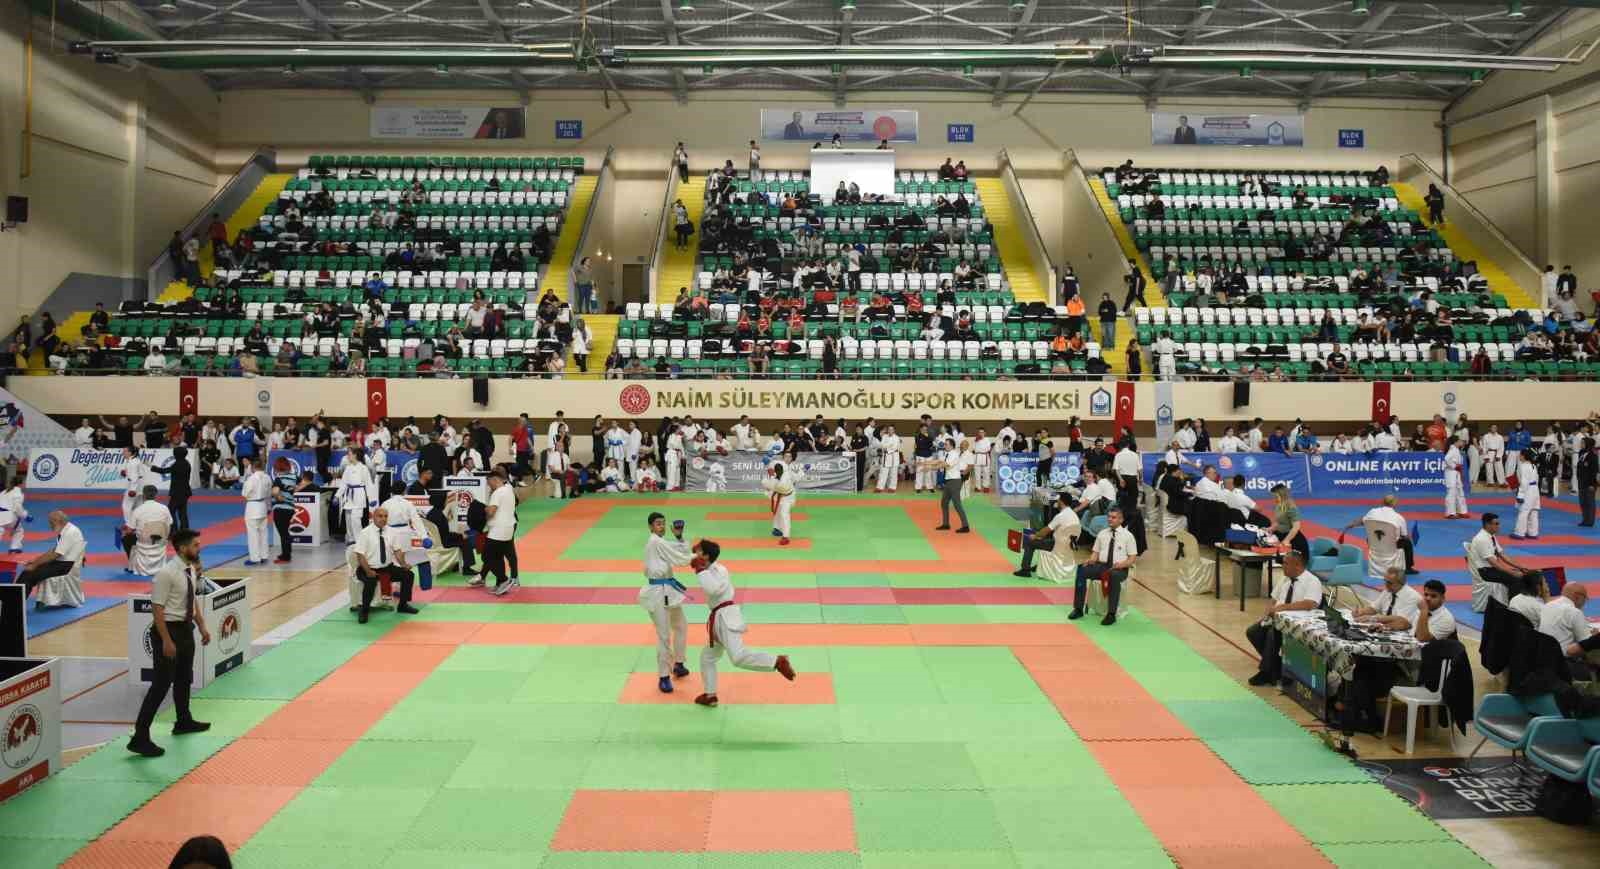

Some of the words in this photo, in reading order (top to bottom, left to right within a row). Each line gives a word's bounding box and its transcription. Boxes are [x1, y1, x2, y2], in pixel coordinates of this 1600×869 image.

[656, 387, 713, 409] NAİM
[719, 388, 895, 409] SÜLEYMANOĞLU
[901, 391, 958, 409] SPOR
[962, 388, 1080, 409] KOMPLEKSİ
[1325, 460, 1379, 472] ONLINE
[1383, 460, 1421, 472] KAYIT
